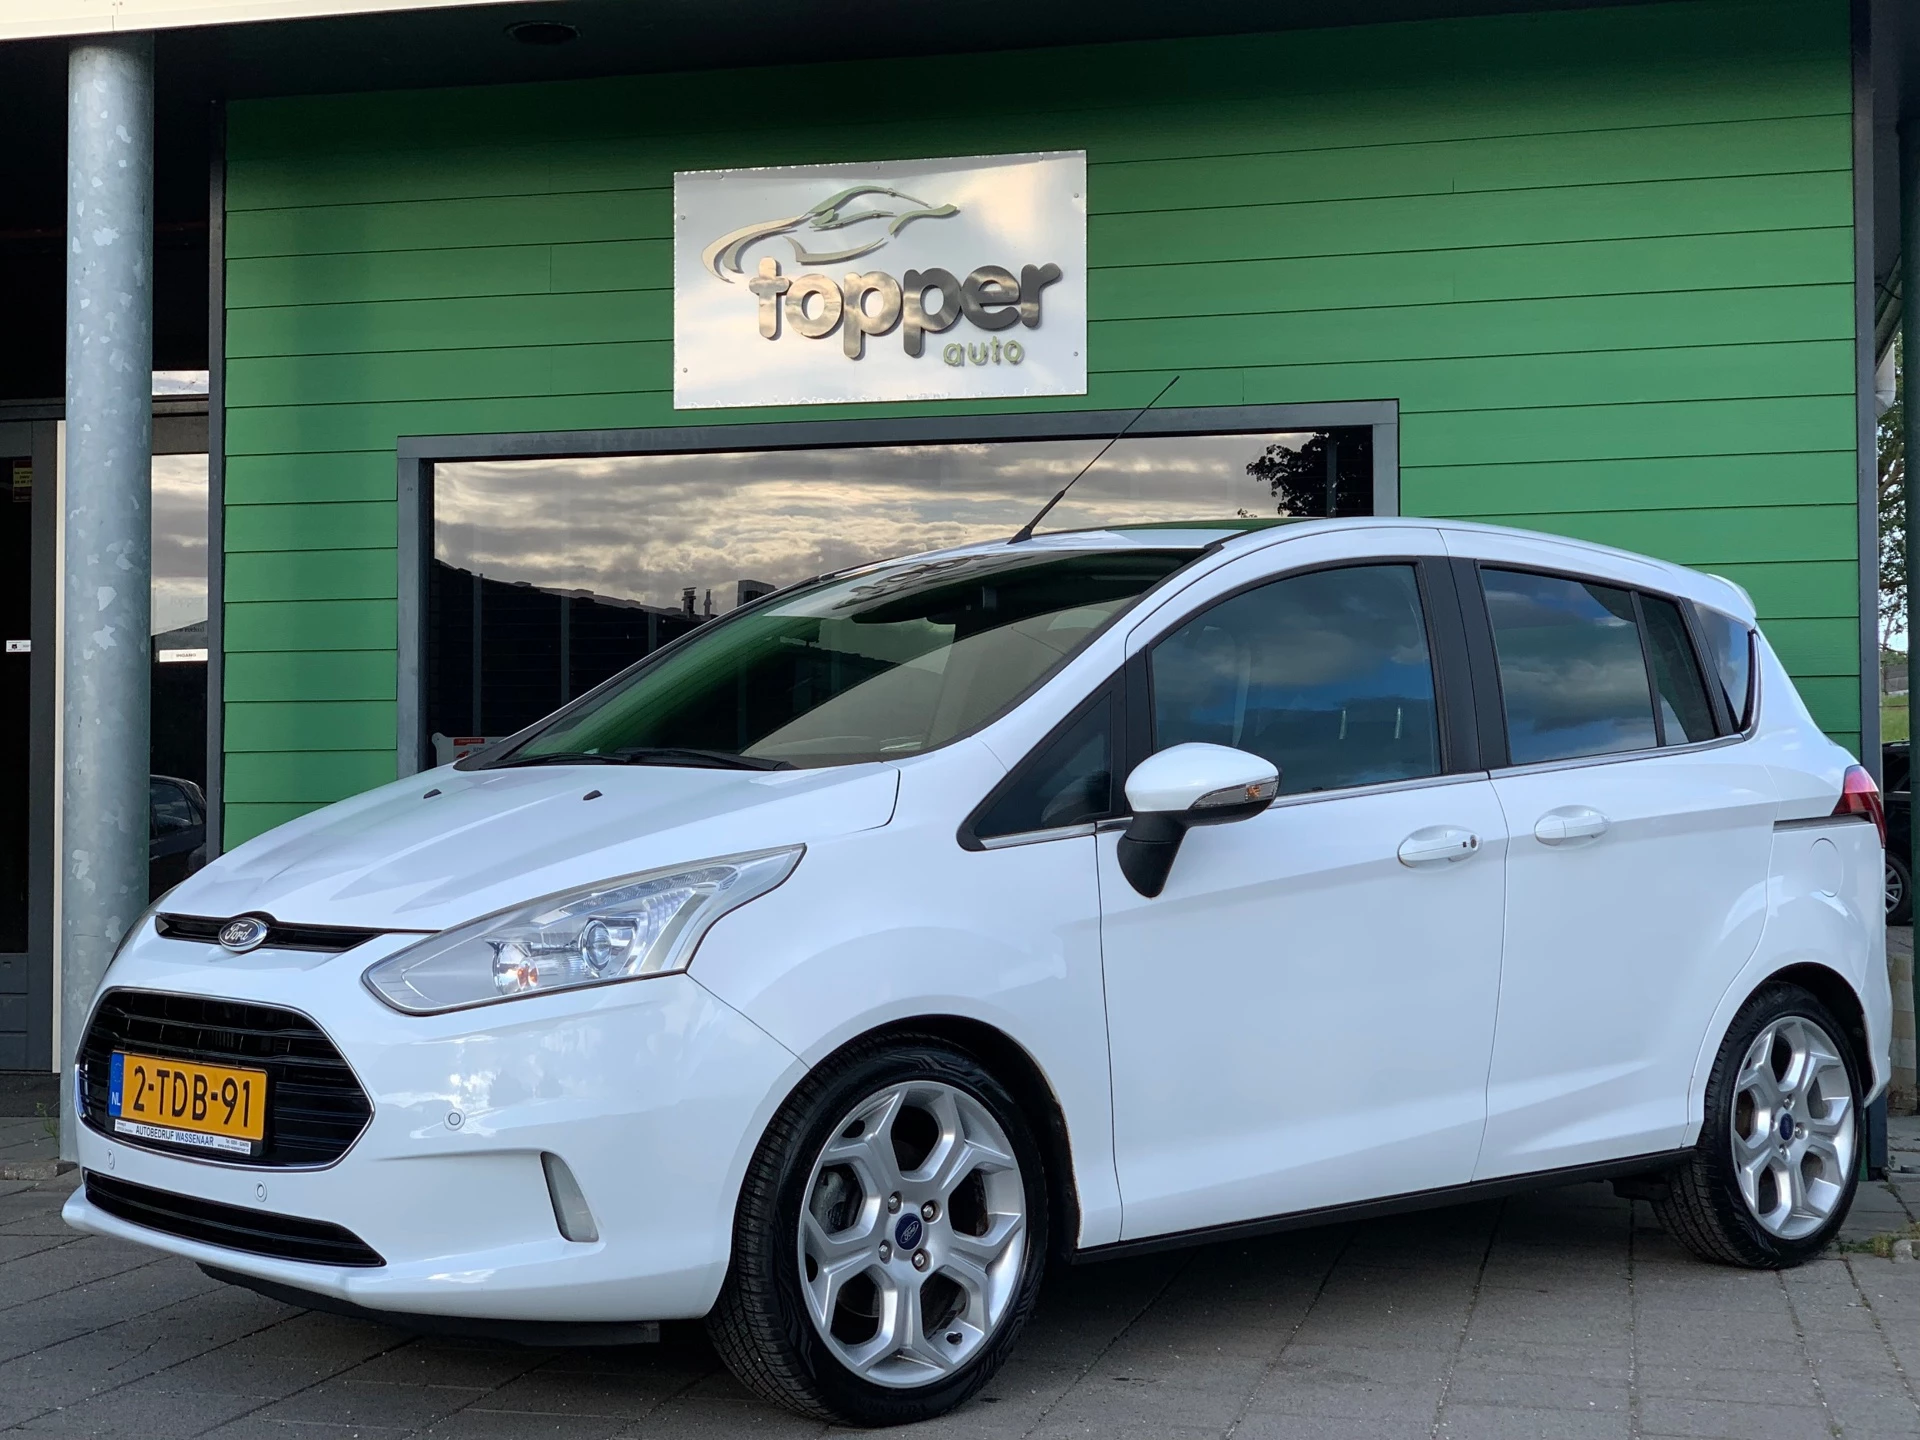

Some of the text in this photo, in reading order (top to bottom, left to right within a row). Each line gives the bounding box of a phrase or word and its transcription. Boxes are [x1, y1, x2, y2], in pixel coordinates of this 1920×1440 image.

[748, 256, 1062, 358] topper
[943, 336, 1024, 366] auto
[224, 922, 253, 941] Ford
[111, 1091, 121, 1107] NL
[133, 1065, 251, 1128] 2-TDB-91
[135, 1124, 175, 1140] AUTOBEDRIJF
[175, 1131, 214, 1147] WASSENAAR
